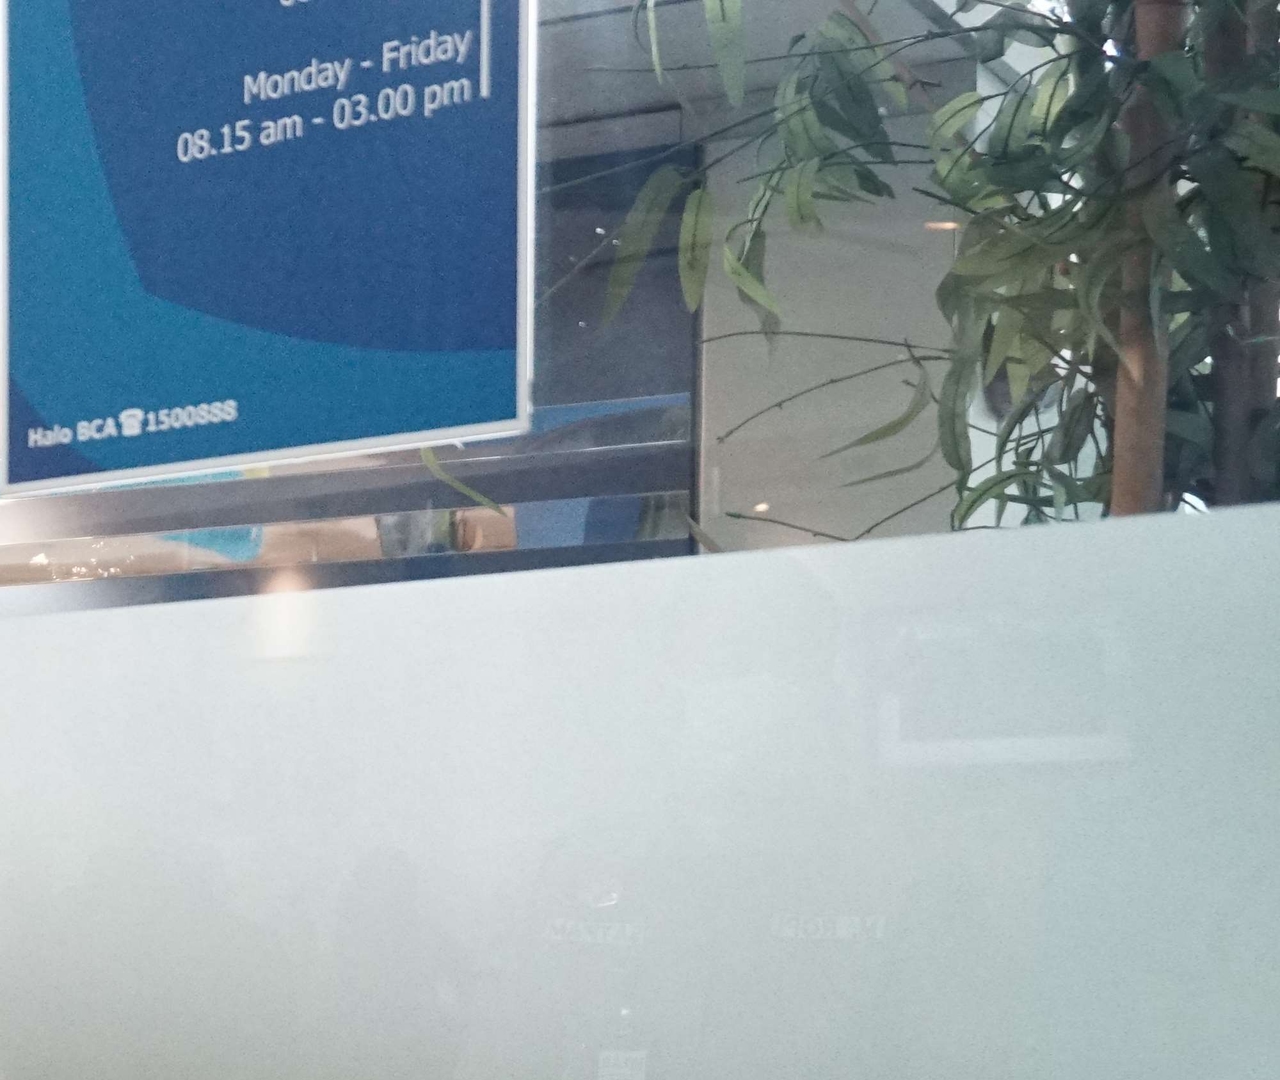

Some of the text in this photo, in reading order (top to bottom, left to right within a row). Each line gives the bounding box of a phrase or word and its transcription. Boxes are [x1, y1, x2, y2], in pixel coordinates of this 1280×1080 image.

[243, 54, 352, 103] Monday
[382, 29, 472, 73] Friday
[177, 120, 252, 162] 08.15
[259, 111, 303, 145] am
[332, 84, 414, 130] 03.00
[422, 76, 471, 118] pm
[27, 399, 238, 447] Halo BCA 1500888
